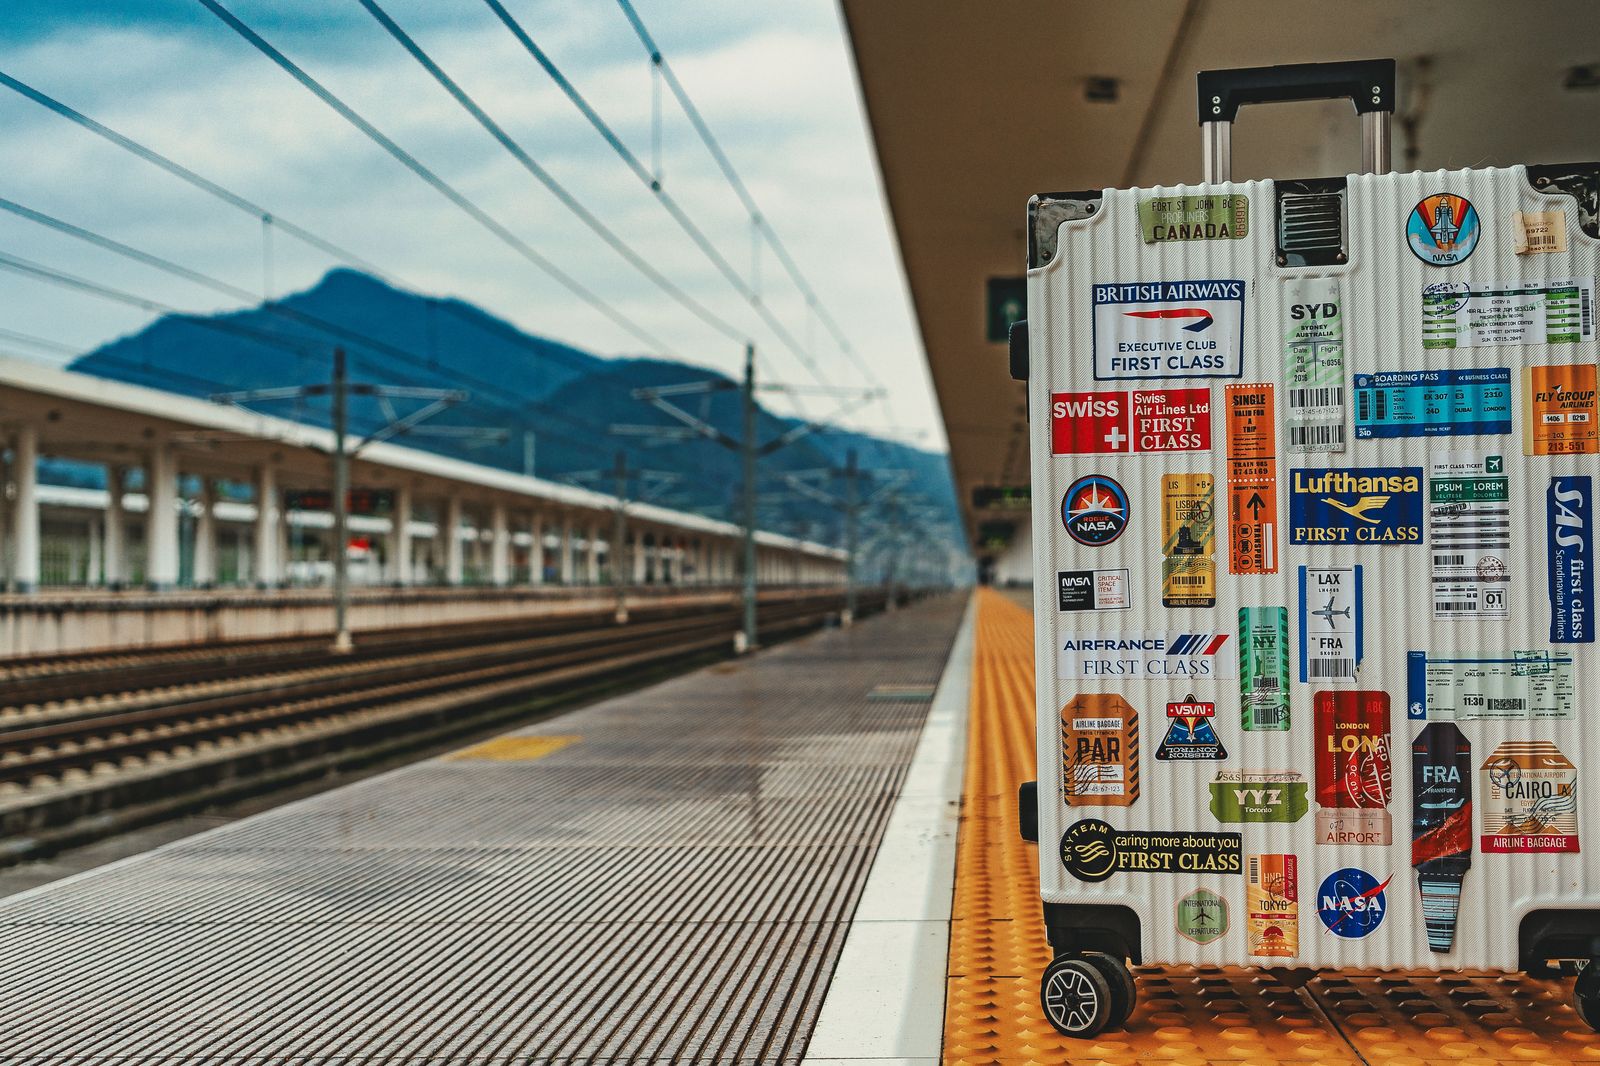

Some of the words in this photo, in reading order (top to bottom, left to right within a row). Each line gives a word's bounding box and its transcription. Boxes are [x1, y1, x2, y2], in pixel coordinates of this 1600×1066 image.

[1152, 201, 1172, 212] FORT
[1177, 200, 1187, 211] ST
[1195, 200, 1214, 210] JOHN
[1223, 199, 1232, 209] BC
[1153, 223, 1230, 240] CANADA
[1432, 253, 1459, 262] NASA
[1096, 285, 1162, 302] BRITISH
[1167, 282, 1241, 300] AIRWAYS
[1290, 302, 1338, 320] SYD
[1118, 341, 1182, 352] EXECUTIVE
[1186, 341, 1217, 350] CLUB
[1111, 357, 1161, 371] FIRST
[1167, 355, 1224, 370] CLASS
[1375, 374, 1418, 382] BOARDING
[1135, 393, 1166, 404] Swiss
[1233, 394, 1266, 406] SINGLE
[1536, 392, 1554, 402] FLY
[1556, 391, 1595, 401] GROUP
[1053, 396, 1119, 418] swiss
[1135, 405, 1152, 416] Air
[1156, 404, 1185, 415] Lines
[1140, 418, 1195, 433] FIRST
[1140, 434, 1201, 449] CLASS
[1548, 442, 1585, 452] 213-551
[1168, 481, 1179, 489] LIS
[1295, 472, 1418, 494] Lufthansa
[1435, 484, 1462, 492] IPSUM
[1473, 483, 1503, 491] LOREM
[1176, 500, 1201, 509] LISBOA
[1554, 481, 1584, 552] SAS
[1077, 521, 1116, 532] NASA
[1295, 527, 1349, 541] FIRST
[1356, 526, 1419, 541] CLASS
[1254, 523, 1262, 569] TRANSPORT
[1062, 577, 1091, 586] NASA
[1318, 574, 1340, 584] LAX
[1556, 550, 1565, 605] Scandinavian
[1571, 558, 1584, 595] first
[1486, 594, 1502, 604] 01
[1556, 606, 1565, 640] Airlines
[1571, 599, 1584, 639] class
[1063, 640, 1164, 650] AIRFRANCE
[1253, 636, 1276, 648] NY
[1320, 638, 1343, 648] FRA
[1084, 660, 1139, 674] FIRST
[1147, 660, 1210, 675] CLASS
[1463, 697, 1484, 706] 11:30
[1097, 720, 1120, 729] BAGGAGE
[1077, 737, 1120, 762] PAR
[1327, 735, 1378, 752] LON
[1423, 766, 1461, 783] FRA
[1506, 781, 1552, 799] CAIRO
[1562, 785, 1568, 796] A
[1233, 789, 1282, 805] YYZ
[1064, 823, 1108, 862] SKYTEAM
[1115, 834, 1149, 850] caring
[1151, 837, 1181, 848] more
[1182, 835, 1216, 848] about
[1218, 839, 1239, 851] you
[1327, 832, 1381, 842] AIRPORT
[1493, 837, 1525, 848] AIRLINE
[1527, 837, 1567, 848] BAGGAGE
[1118, 852, 1173, 870] FIRST
[1179, 853, 1240, 871] CLASS
[1264, 872, 1281, 883] HND
[1259, 900, 1287, 911] TOKYO
[1323, 896, 1383, 912] NASA
